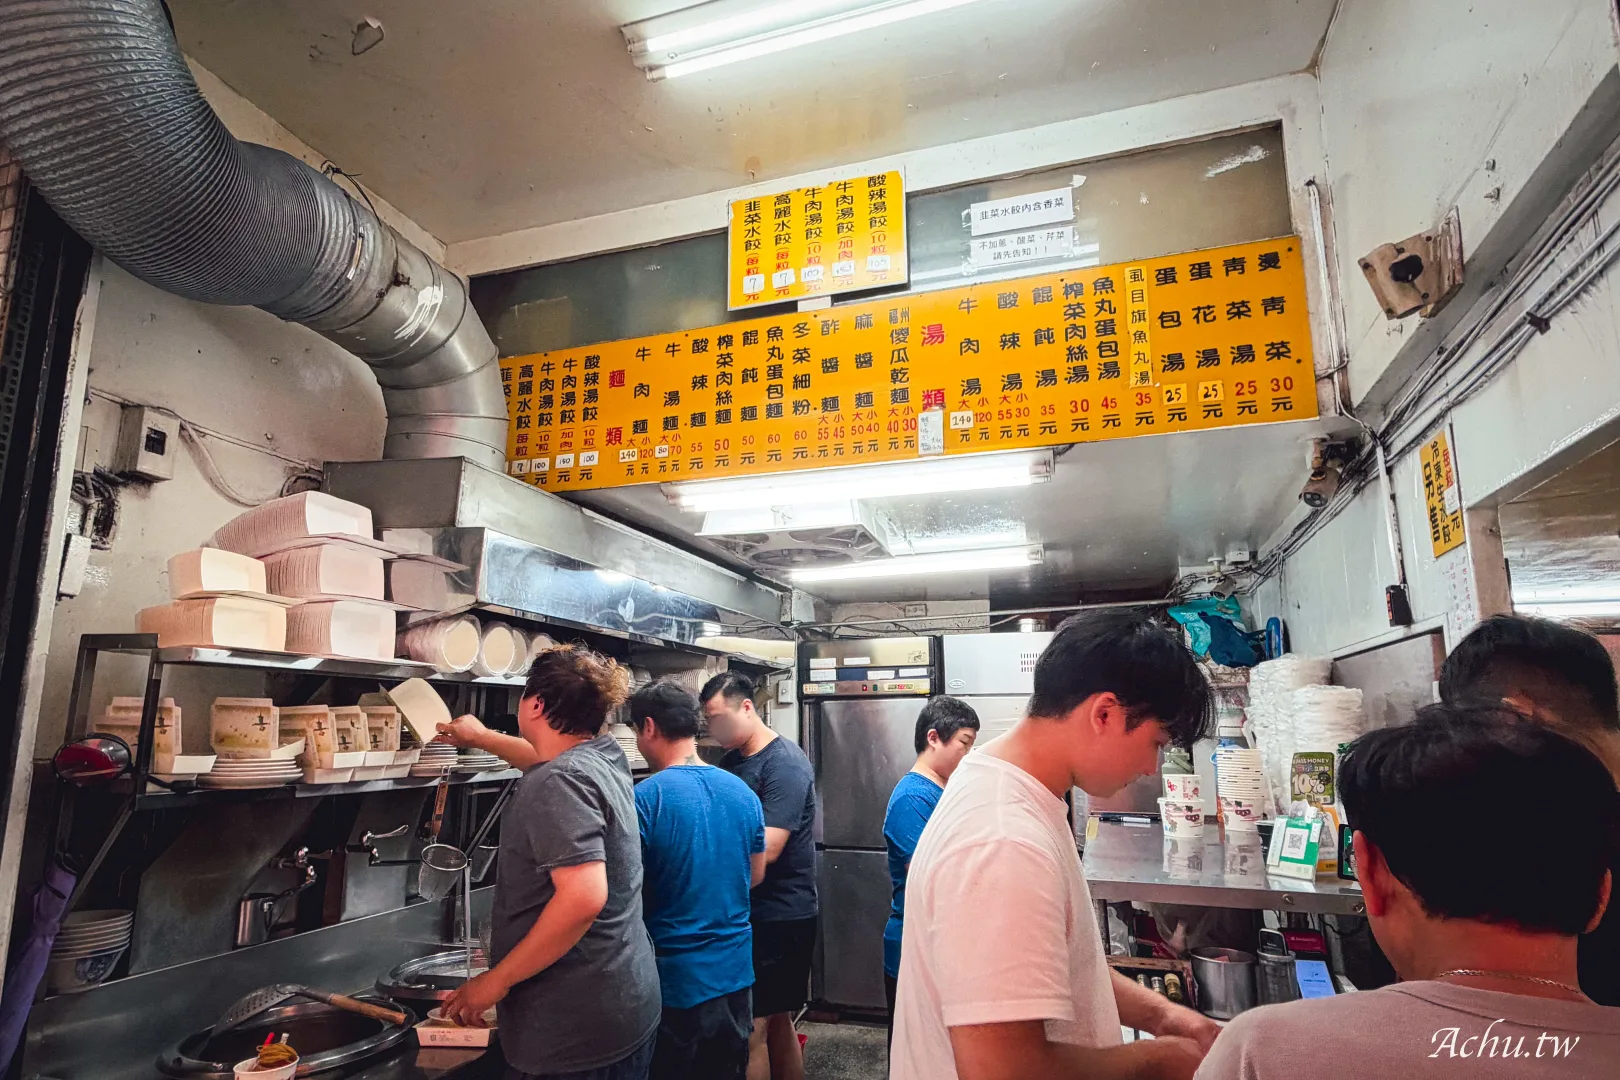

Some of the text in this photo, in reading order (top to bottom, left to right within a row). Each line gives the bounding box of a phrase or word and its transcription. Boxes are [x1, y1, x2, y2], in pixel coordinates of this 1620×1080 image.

[836, 181, 854, 234] 牛肉湯餃
[868, 175, 887, 229] 酸辣湯餃
[980, 197, 1064, 220] 韭菜水餃內含香菜
[774, 194, 791, 246] 高麗水餃
[805, 188, 823, 239] 牛肉湯餃
[744, 201, 761, 251] 韭菜水餃
[958, 298, 981, 397] 牛肉湯
[998, 292, 1022, 392] 酸辣湯
[1129, 269, 1154, 426] 虱目旗魚丸湯 35 元
[1155, 267, 1187, 422] 蛋包湯 25 元
[1189, 262, 1223, 419] 蛋花湯 25 元
[1062, 283, 1089, 432] 榨菜肉絲湯 30 元
[1092, 277, 1121, 428] 魚丸蛋包湯 45 元
[855, 314, 874, 408] 麻醬麵
[921, 324, 946, 412] 湯類
[1032, 286, 1057, 435] 餛飩湯 35 元
[560, 358, 577, 424] 牛肉湯餃
[582, 355, 600, 422] 酸辣湯餃
[632, 347, 651, 434] 牛肉麵
[663, 343, 681, 431] 牛湯麵
[792, 322, 811, 459] 冬菜細粉 60 元
[1235, 381, 1257, 396] 25
[1271, 377, 1293, 392] 30
[516, 365, 534, 430] 高麗水餃
[538, 362, 555, 427] 牛肉湯餃
[715, 335, 733, 467] 榨菜肉絲麵 50 元
[740, 330, 759, 465] 餛飩麵 50 元
[766, 326, 784, 462] 魚丸蛋包麵 60 元
[606, 370, 625, 446] 麵類
[689, 338, 709, 470] 酸辣麵 55 元
[1237, 401, 1257, 415] 元
[1272, 397, 1292, 412] 元
[952, 415, 971, 425] 140
[975, 412, 992, 422] 120
[998, 410, 1012, 420] 55
[1015, 408, 1030, 417] 30
[851, 425, 864, 435] 50
[866, 423, 879, 433] 40
[887, 420, 899, 433] 40
[903, 418, 916, 430] 30
[1017, 424, 1029, 437] 元
[818, 428, 829, 440] 55
[833, 426, 845, 439] 45
[960, 430, 970, 442] 元
[979, 428, 989, 440] 元
[1000, 426, 1012, 439] 元
[853, 442, 863, 454] 元
[868, 440, 878, 452] 元
[889, 438, 898, 450] 元
[904, 436, 914, 448] 元
[620, 450, 635, 459] 140
[640, 449, 653, 458] 120
[671, 446, 682, 455] 70
[818, 446, 828, 458] 元
[833, 444, 844, 456] 元
[626, 464, 634, 476] 元
[641, 463, 648, 474] 元
[659, 461, 666, 473] 元
[671, 460, 679, 472] 元
[535, 473, 547, 485] 元
[557, 471, 570, 483] 元
[579, 469, 592, 481] 元
[1293, 774, 1325, 795] 10%
